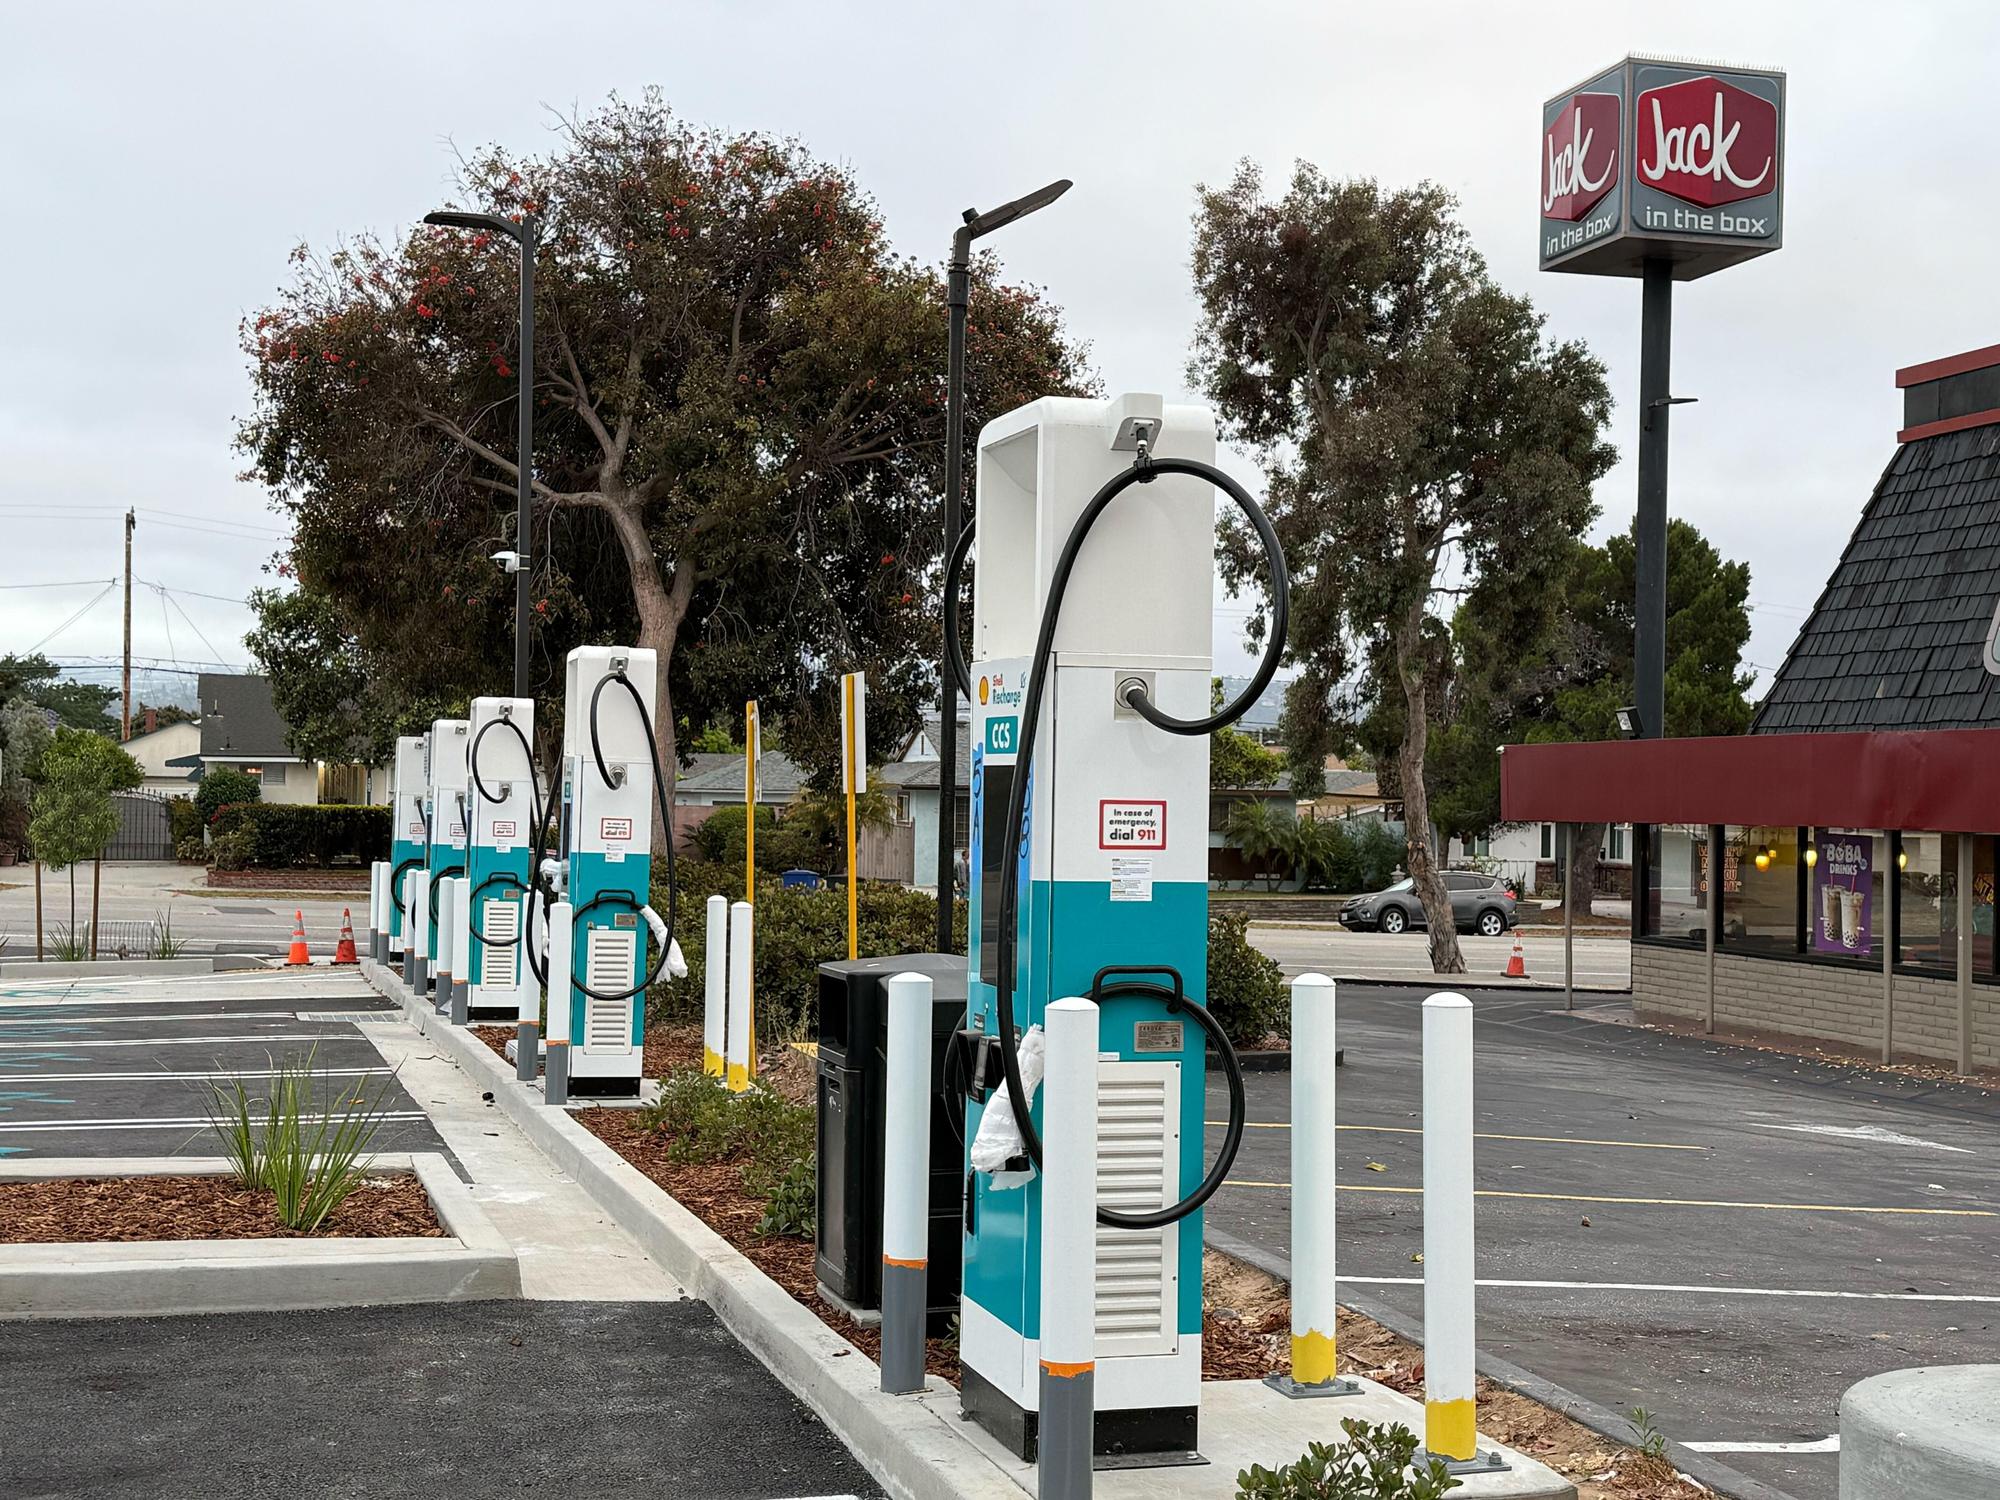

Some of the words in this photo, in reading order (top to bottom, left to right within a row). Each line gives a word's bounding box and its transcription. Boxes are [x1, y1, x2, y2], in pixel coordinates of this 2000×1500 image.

[1641, 91, 1771, 188] Jack
[1544, 107, 1615, 212] Jack
[1646, 205, 1667, 227] in
[1674, 208, 1714, 231] the
[1720, 211, 1766, 235] box
[1546, 236, 1559, 256] in
[1561, 226, 1583, 249] the
[1585, 214, 1613, 240] box
[992, 686, 1021, 708] Recharge
[992, 722, 1011, 750] CCS
[1109, 818, 1157, 828] emergency,
[1113, 808, 1122, 817] In
[1123, 809, 1142, 817] case
[1144, 808, 1153, 817] of
[1109, 828, 1134, 841] dial
[1137, 829, 1156, 841] 911
[1829, 863, 1858, 876] DRINKS
